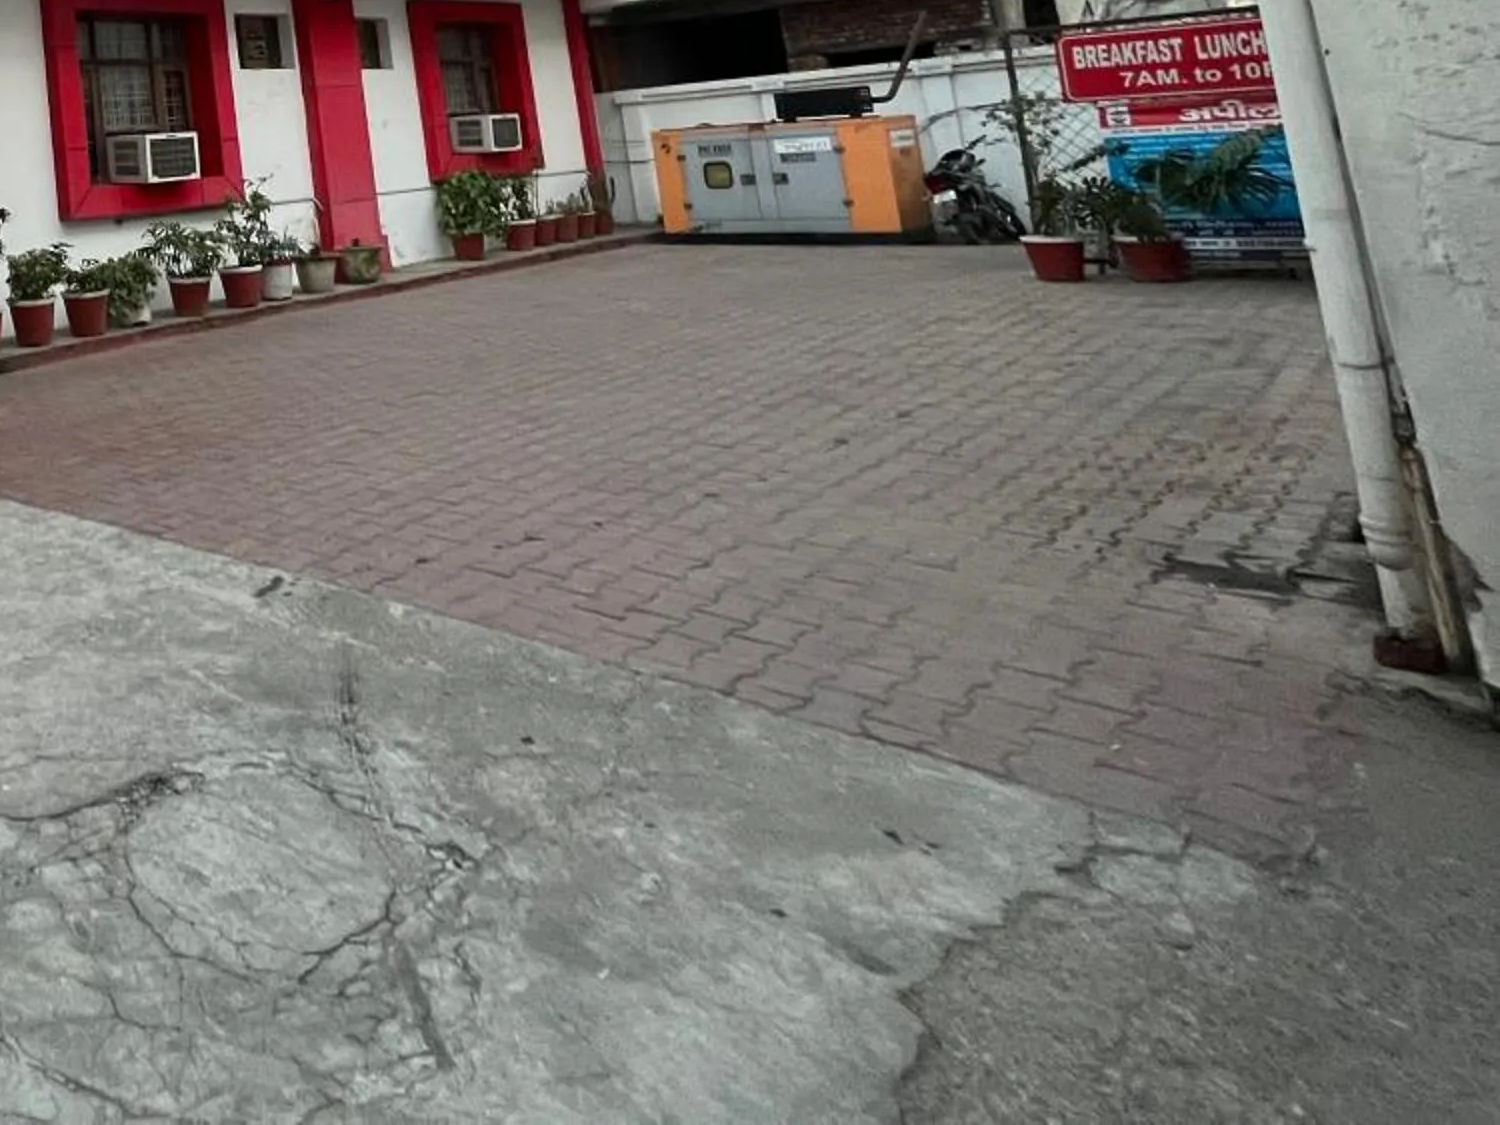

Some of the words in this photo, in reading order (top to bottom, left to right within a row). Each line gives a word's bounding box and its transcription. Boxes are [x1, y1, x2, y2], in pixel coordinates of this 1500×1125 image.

[1073, 38, 1182, 69] BREAKFAST
[1195, 30, 1268, 60] LUNCH
[1119, 67, 1188, 88] 7AM.
[1195, 66, 1223, 84] to
